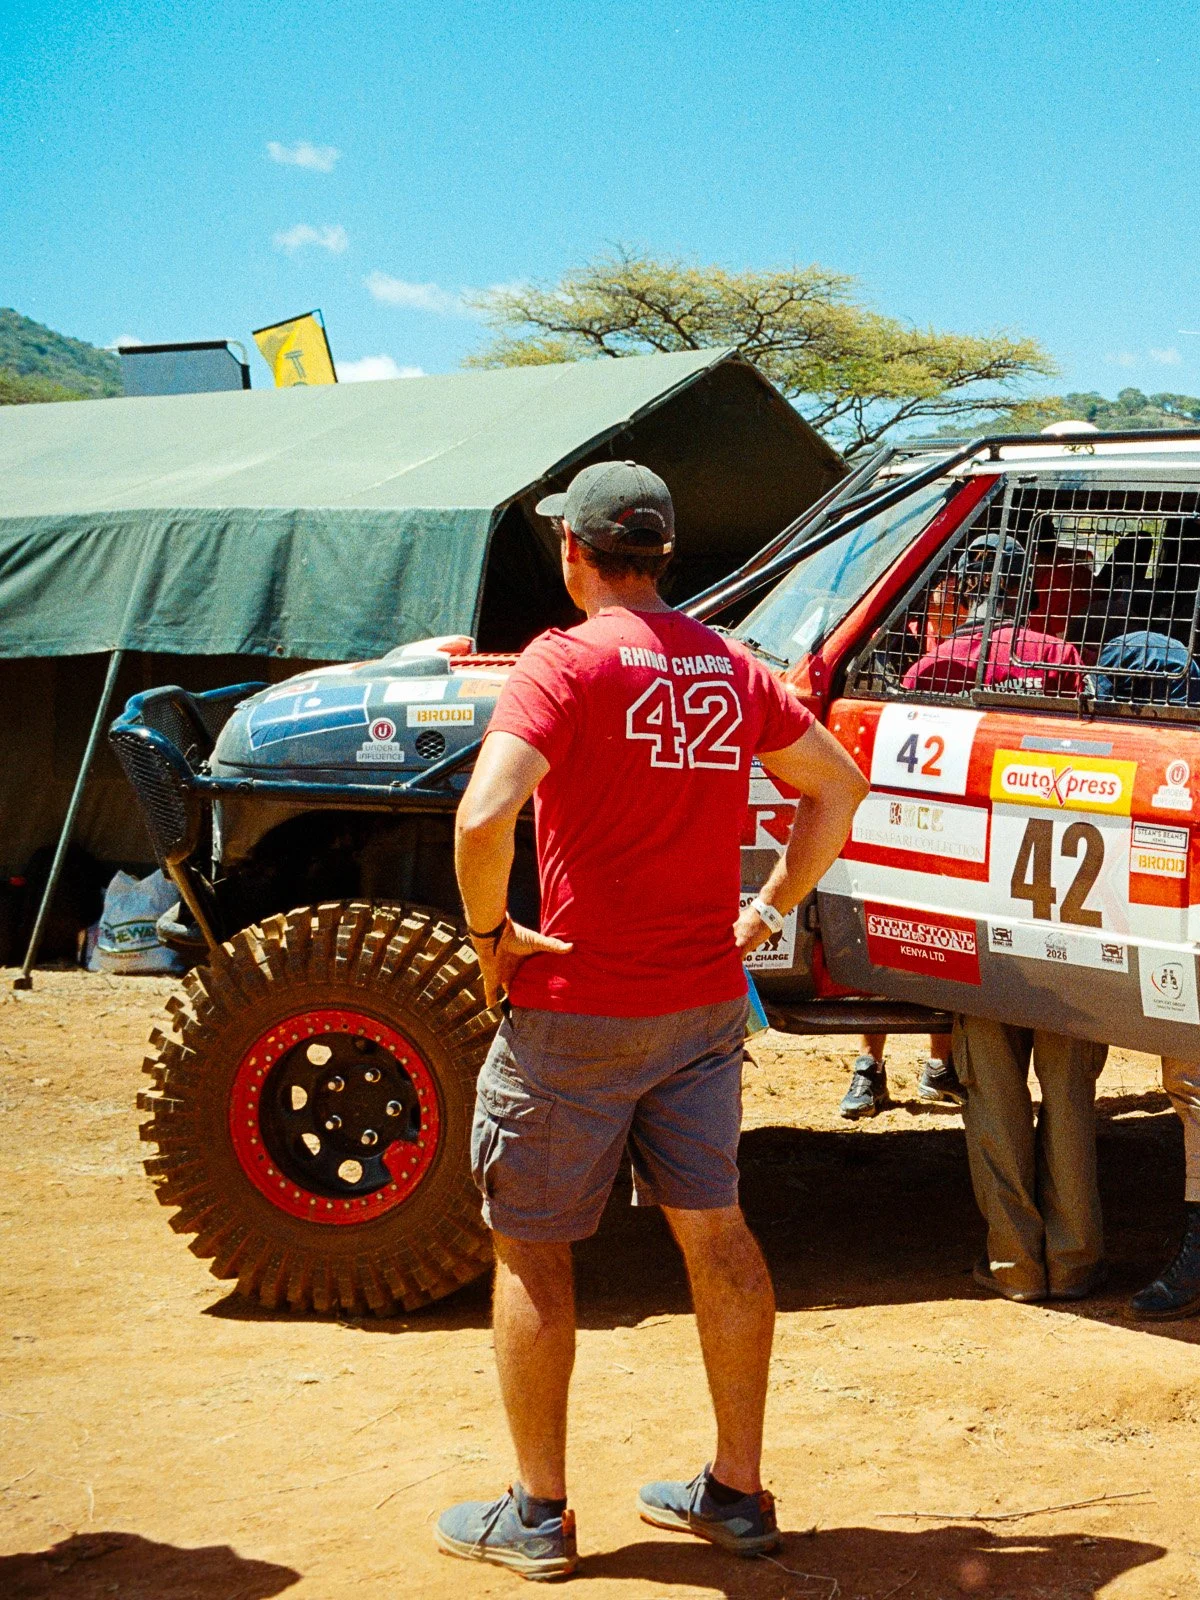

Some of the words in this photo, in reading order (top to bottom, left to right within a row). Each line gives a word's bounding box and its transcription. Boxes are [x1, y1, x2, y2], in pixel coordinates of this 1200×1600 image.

[618, 646, 668, 672] RHINO
[671, 654, 734, 676] CHARGE
[416, 709, 473, 722] BROOD
[626, 677, 743, 770] 42
[896, 733, 945, 777] 42
[1011, 817, 1105, 928] 42
[1138, 854, 1185, 873] BROOD
[868, 915, 975, 951] STEELSTONE
[755, 953, 789, 961] CHARGE
[900, 945, 928, 959] KENYA
[929, 951, 946, 962] LTD.
